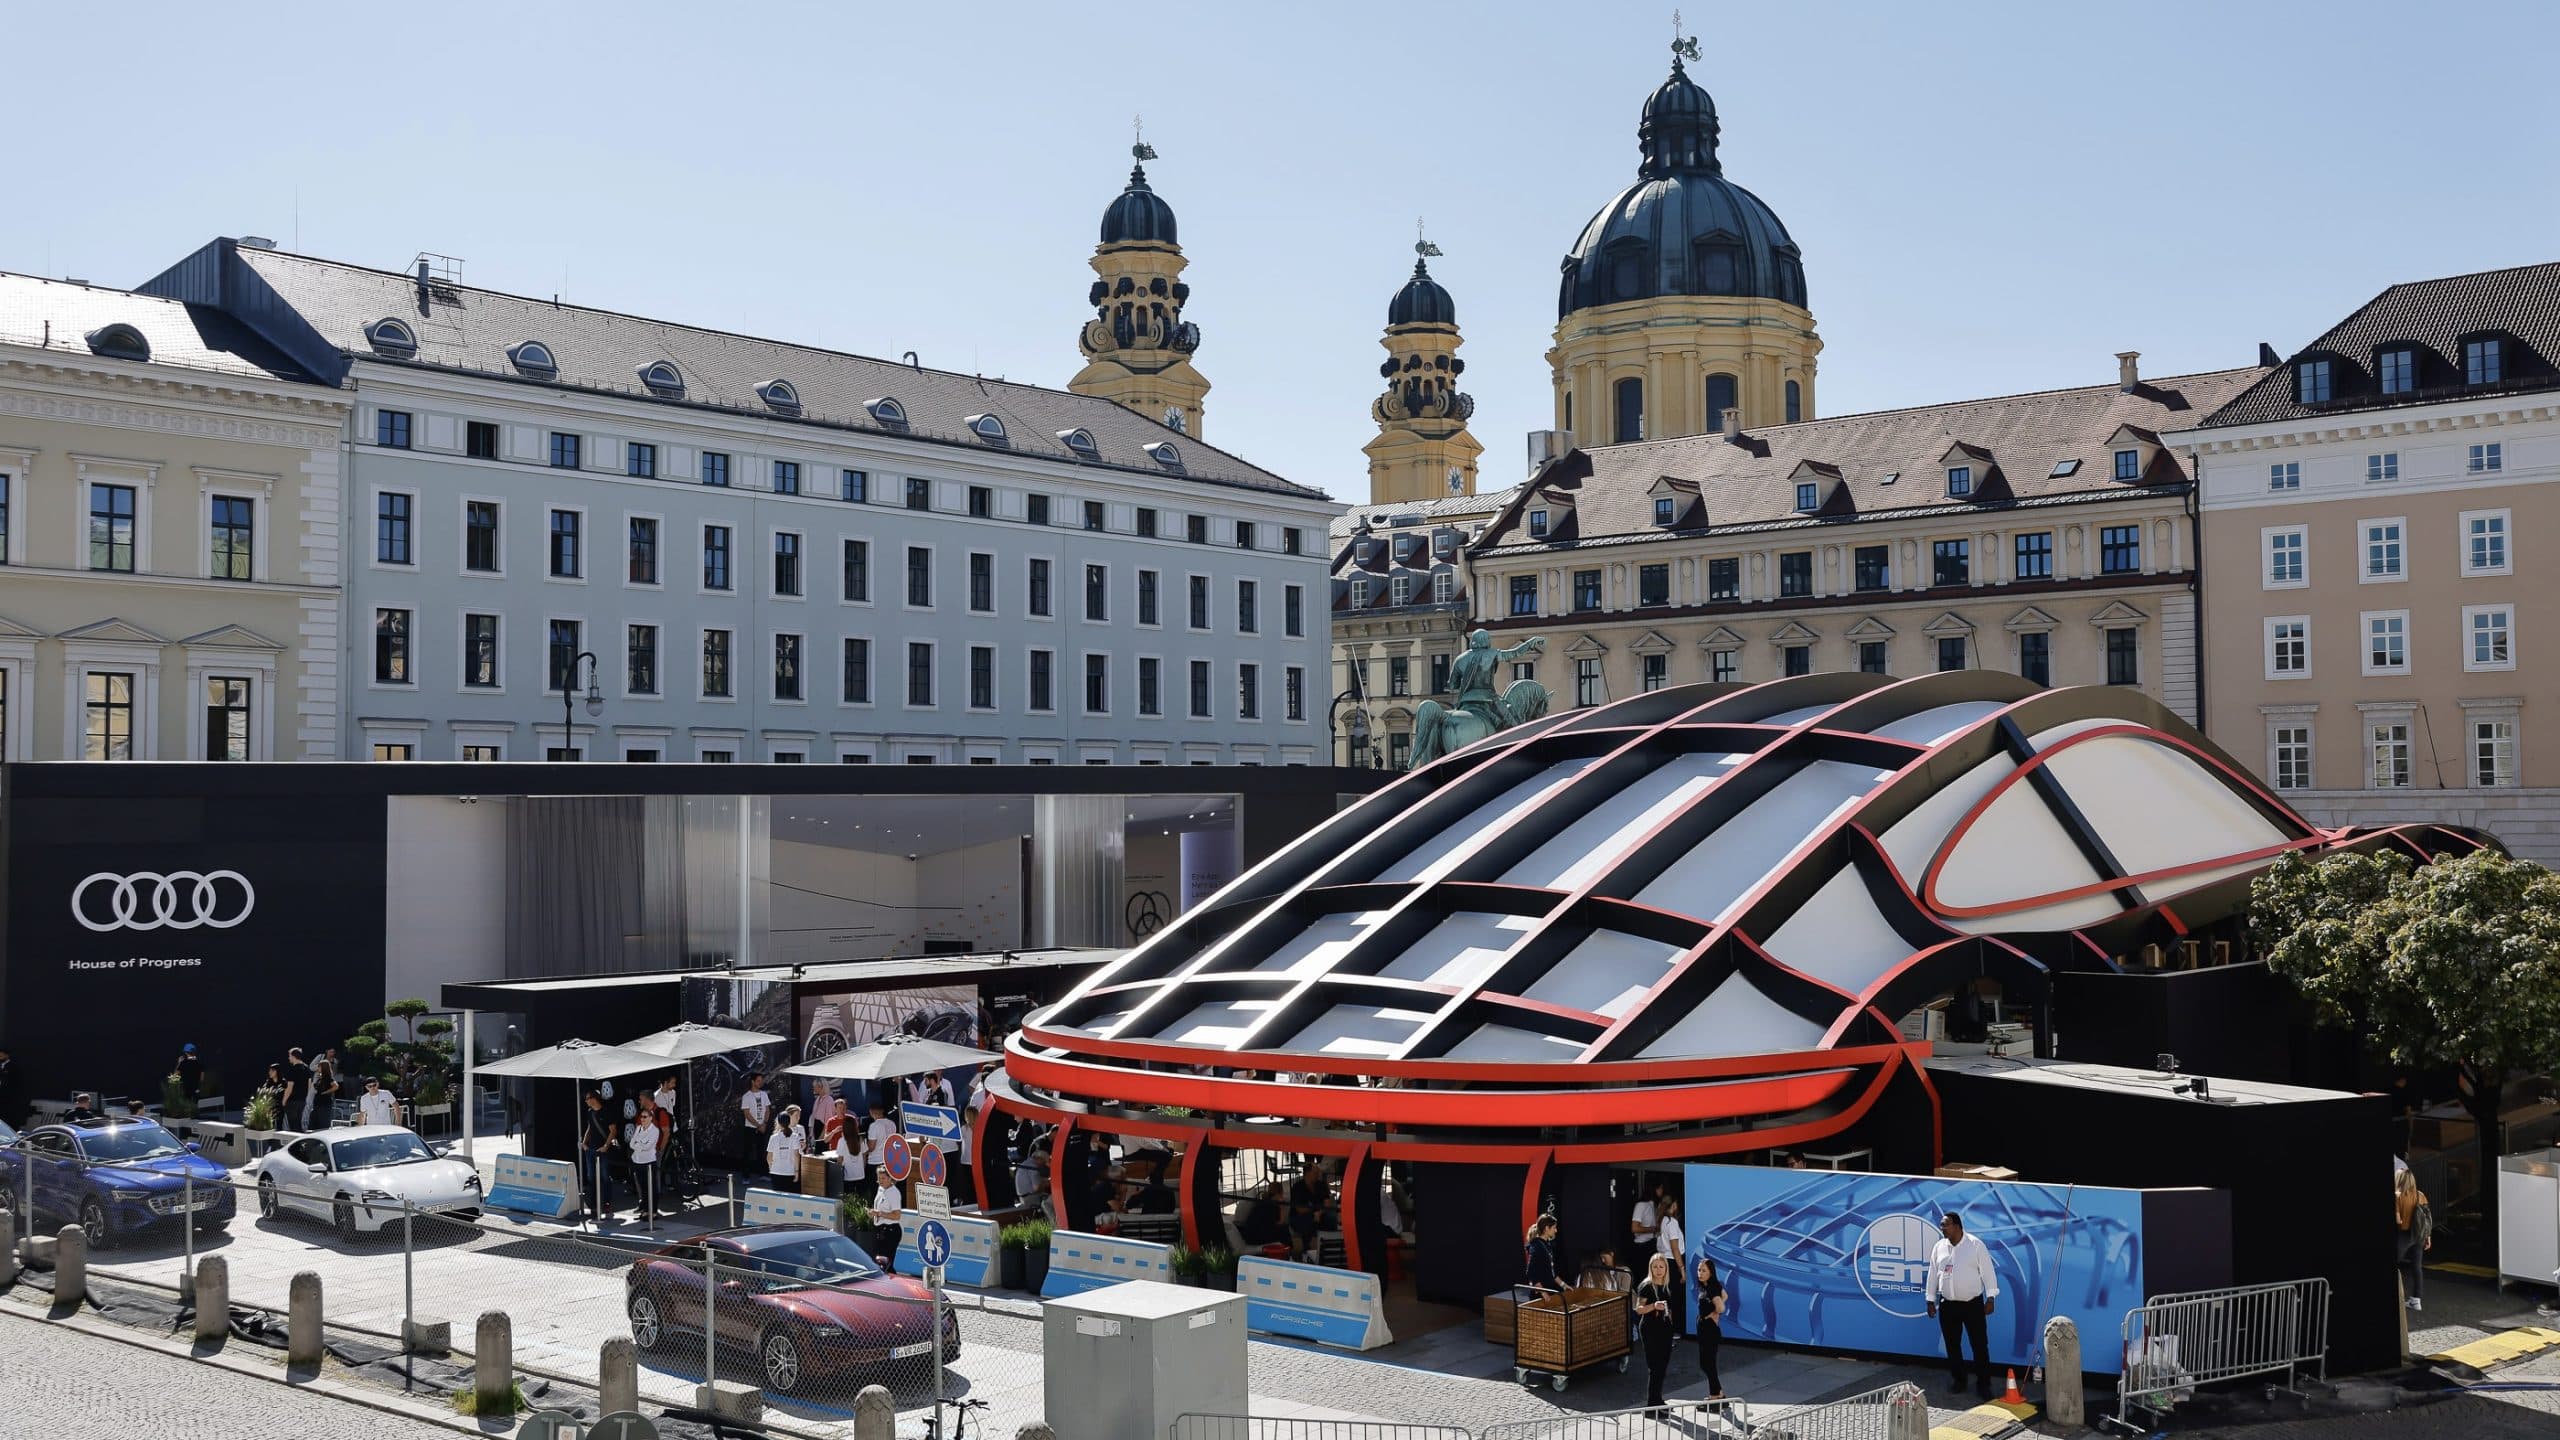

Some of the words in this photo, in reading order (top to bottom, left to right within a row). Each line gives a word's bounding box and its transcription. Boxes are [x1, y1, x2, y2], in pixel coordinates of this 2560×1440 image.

[69, 960, 116, 969] House
[119, 958, 136, 968] of
[139, 958, 202, 969] Progress
[1871, 1260, 1930, 1284] 91
[1270, 1313, 1325, 1328] PORSCHE
